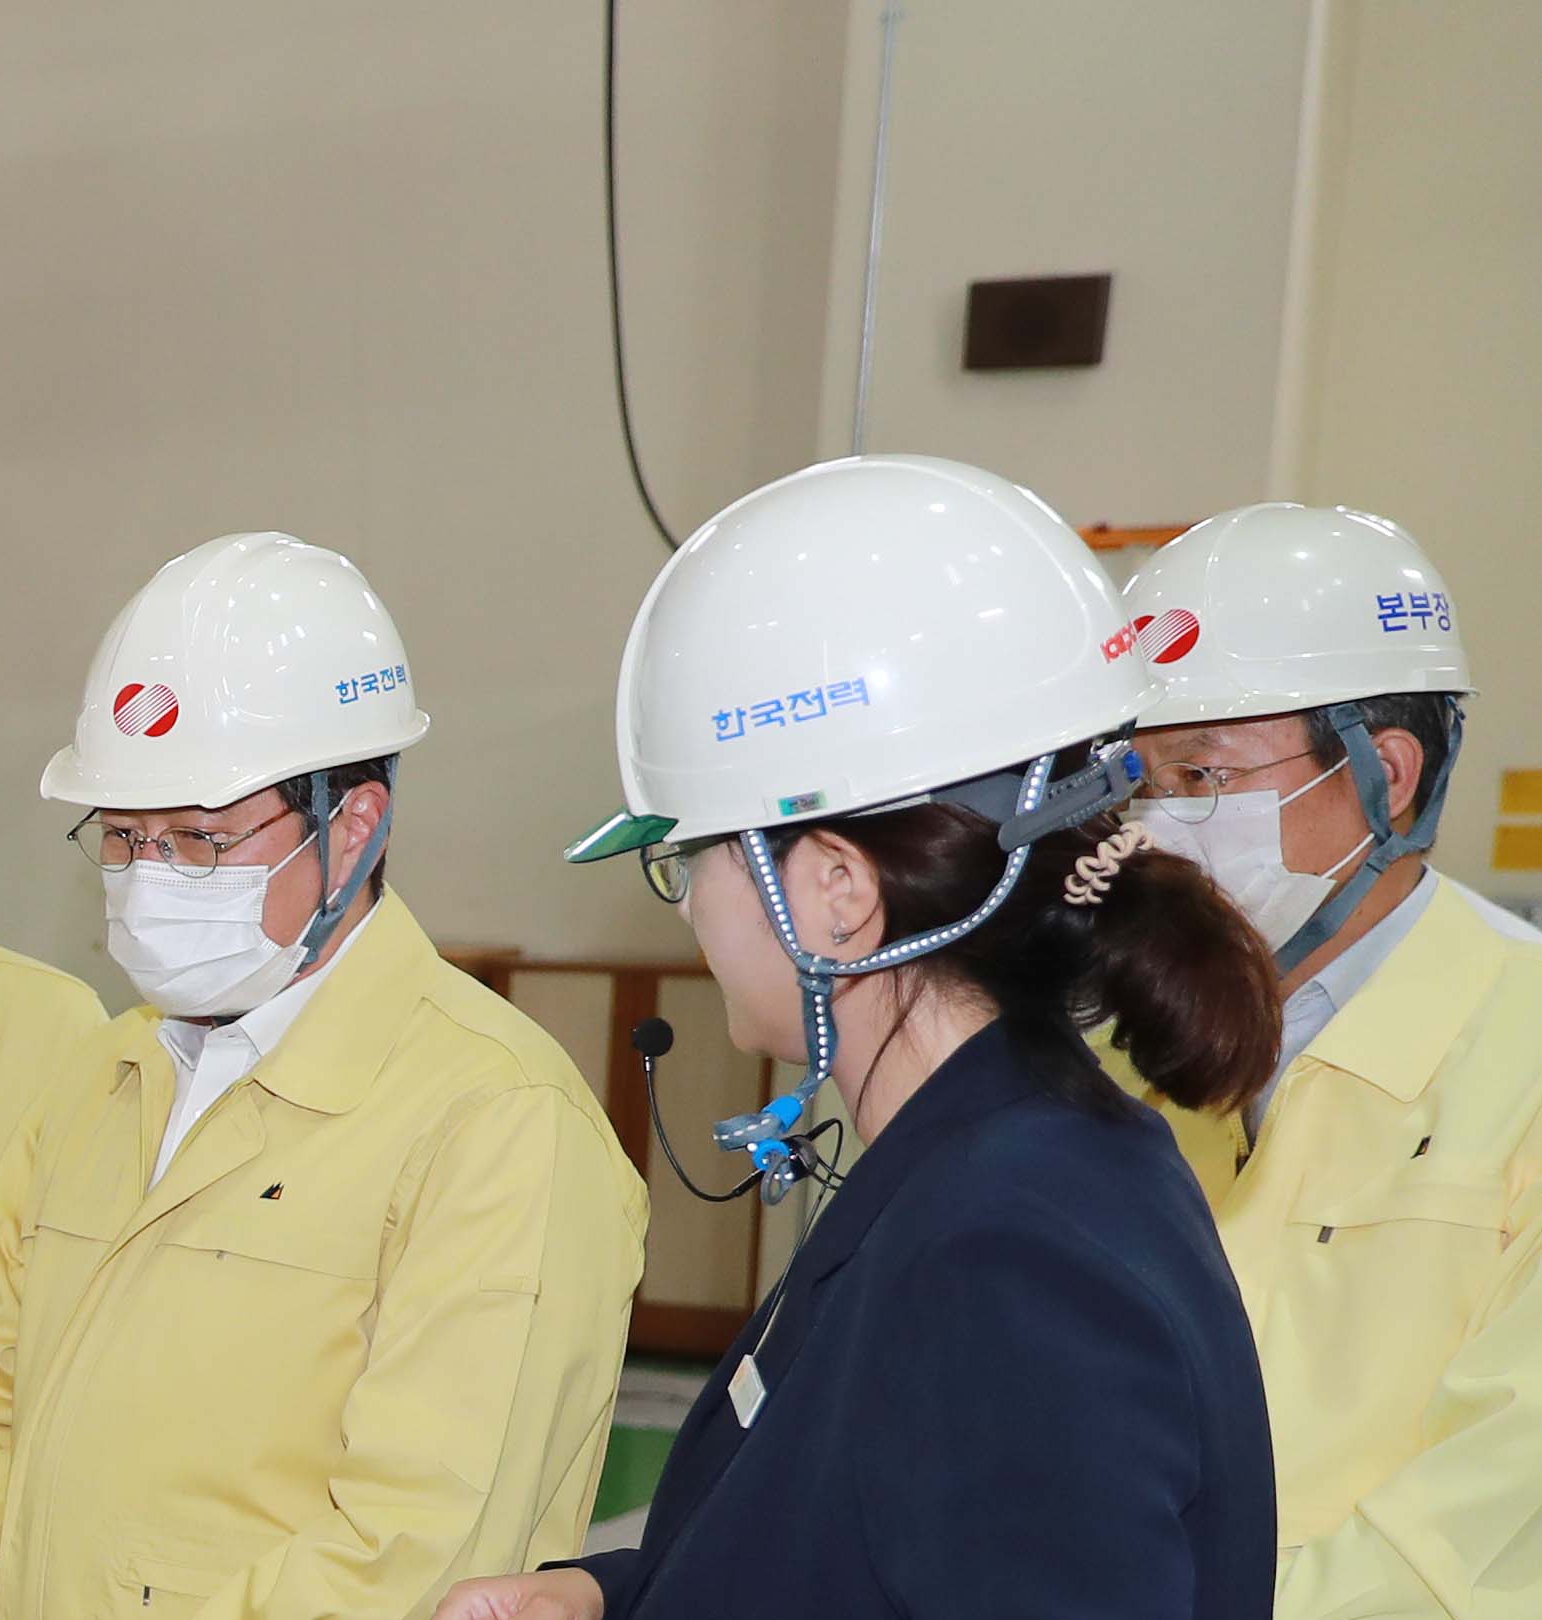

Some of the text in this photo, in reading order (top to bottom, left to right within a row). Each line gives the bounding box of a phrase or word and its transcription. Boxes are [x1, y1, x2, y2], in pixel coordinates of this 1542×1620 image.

[1375, 592, 1451, 632] 본부장
[334, 663, 408, 705] 한국전력
[711, 676, 871, 742] 한국전력
